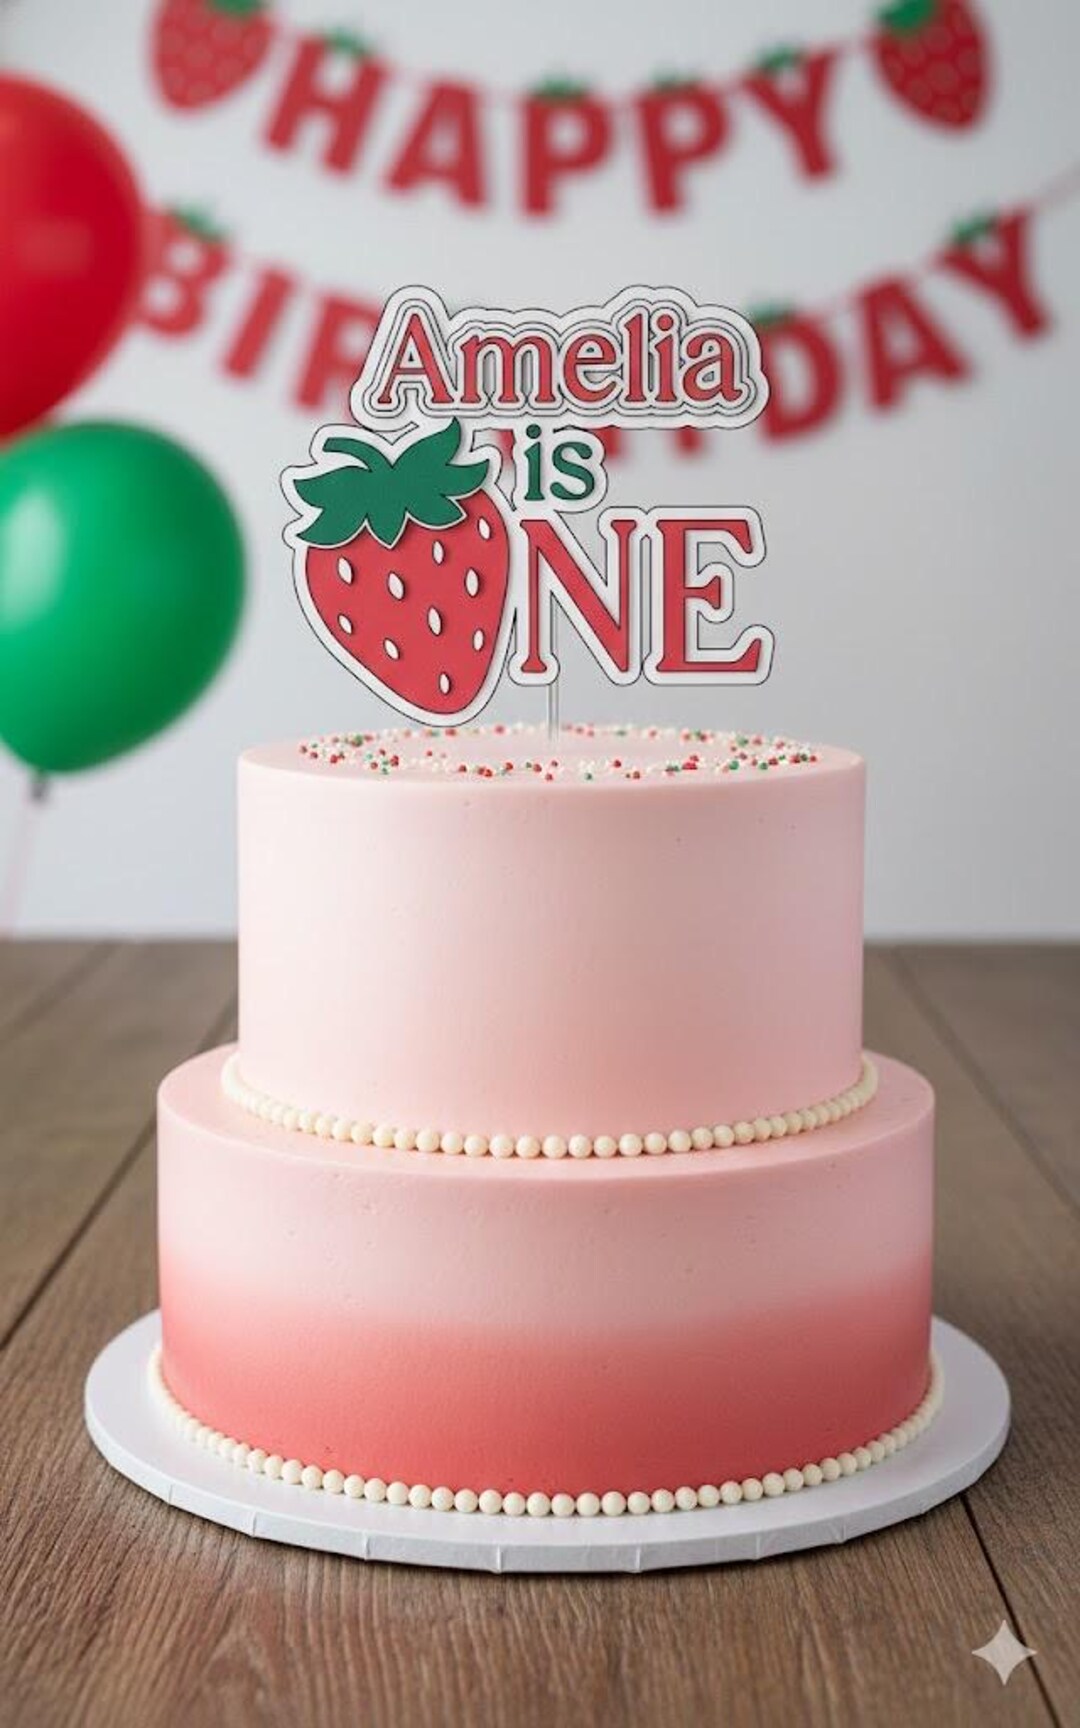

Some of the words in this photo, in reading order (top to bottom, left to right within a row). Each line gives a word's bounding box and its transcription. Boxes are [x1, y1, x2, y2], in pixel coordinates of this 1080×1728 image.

[266, 34, 836, 216] HAPPY
[140, 208, 1046, 460] BIRDAY
[376, 312, 744, 405] Amelia
[523, 422, 597, 501] is
